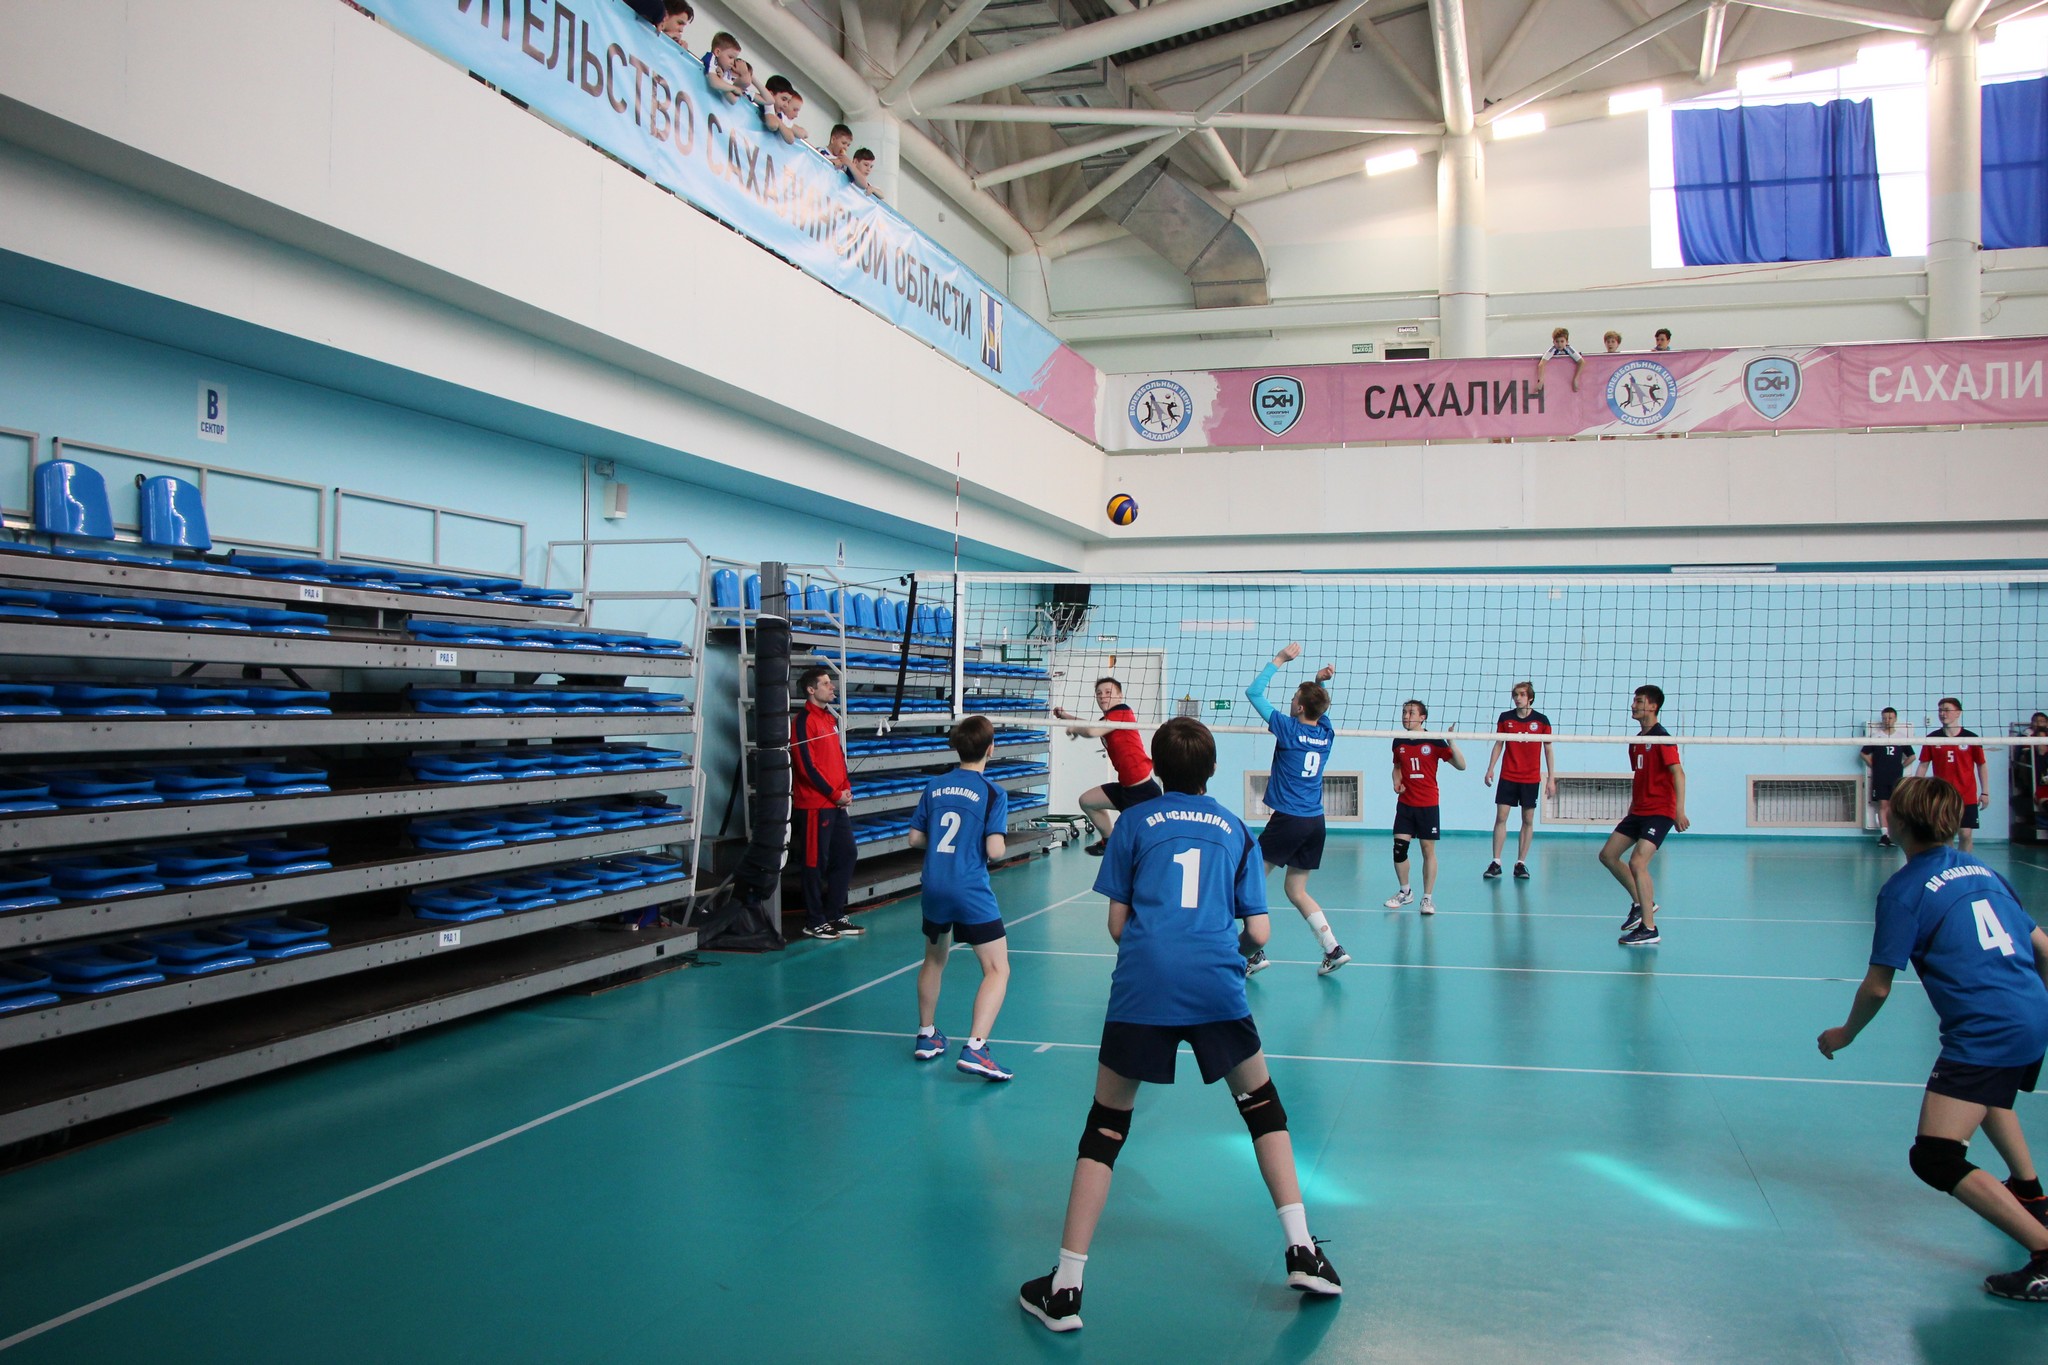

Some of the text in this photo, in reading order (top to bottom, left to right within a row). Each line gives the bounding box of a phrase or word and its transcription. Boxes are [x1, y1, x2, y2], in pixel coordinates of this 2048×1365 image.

[894, 246, 972, 340] ОБЛАСТИ
[1607, 361, 1676, 399] ВОЛЕЙБОЛЬНЫЙ ЦЕНТР
[1868, 360, 2043, 404] САХАЛИ
[207, 388, 219, 420] В
[1129, 381, 1192, 416] ВОЛЕЙБОЛЬНЫЙ ЦЕНТР
[1364, 379, 1545, 419] САХАЛИН
[200, 421, 225, 435] СЕКТОР
[1620, 413, 1663, 425] САХАЛИН
[1141, 430, 1179, 440] САХАЛИН
[304, 588, 314, 598] РЯД
[439, 653, 454, 663] РЯД 5
[1886, 746, 1895, 756] 12
[1947, 750, 1955, 763] 5
[1301, 751, 1321, 778] 9
[1410, 757, 1420, 771] 11
[931, 788, 942, 798] ВЦ
[936, 811, 961, 853] 2
[1146, 810, 1232, 834] ВЦ «САХАЛИН»
[1173, 848, 1201, 908] 1
[1925, 875, 1946, 893] ВЦ
[443, 933, 453, 943] РЯД
[1970, 898, 2016, 957] 4
